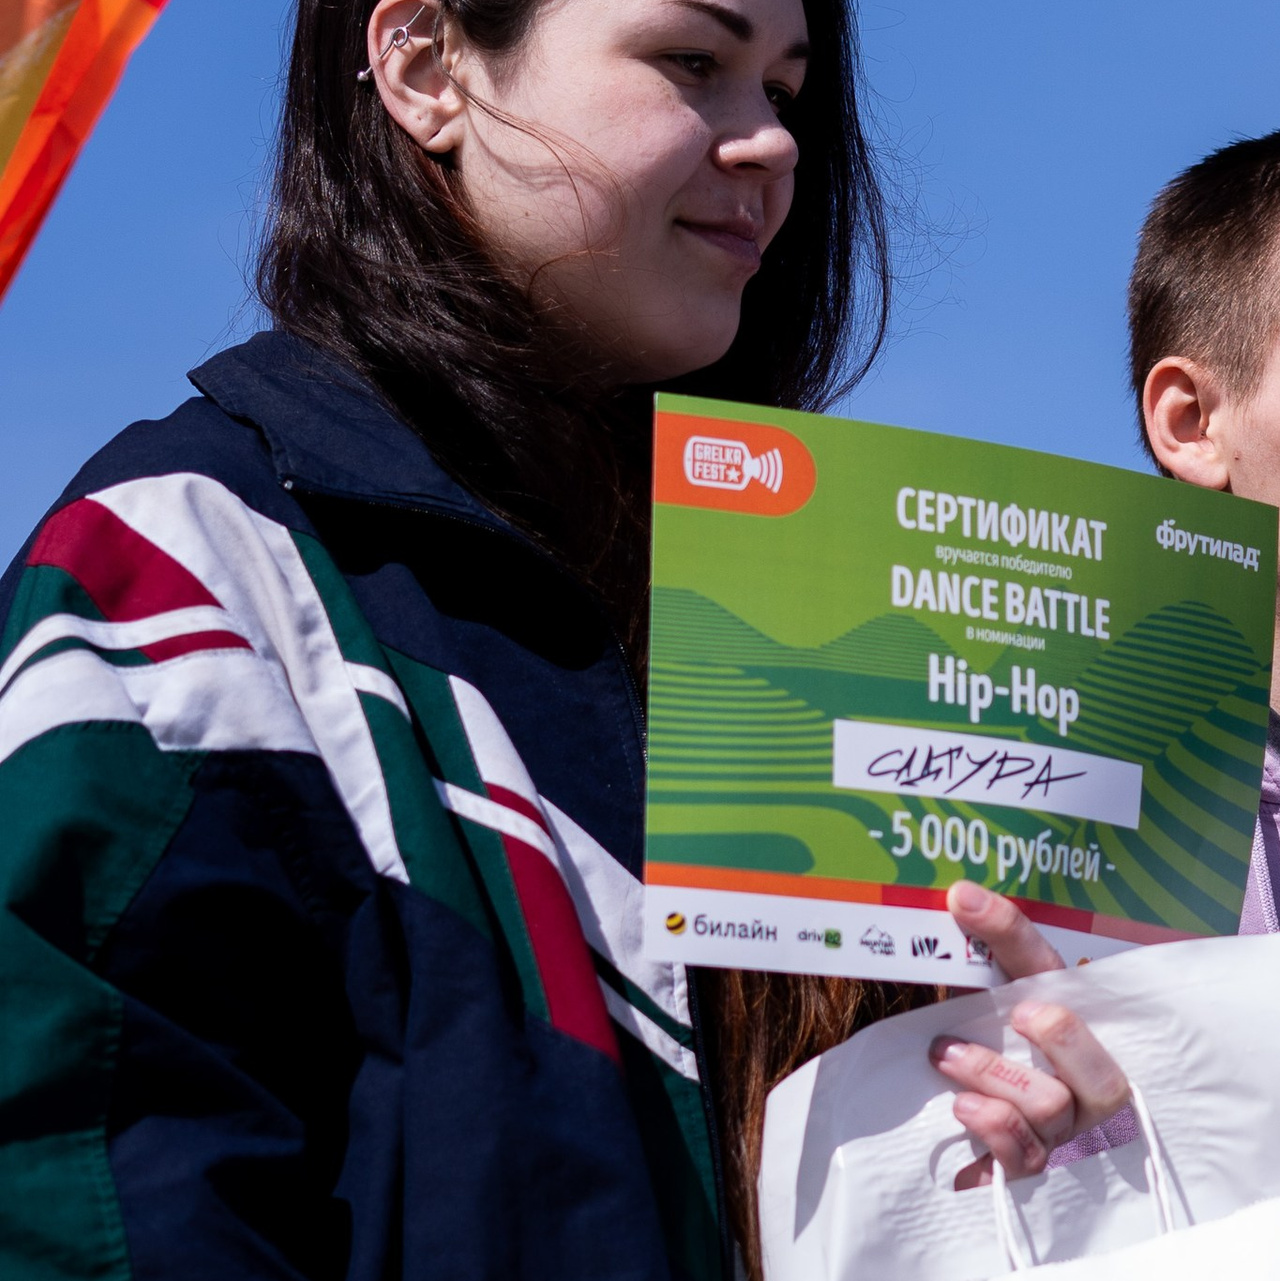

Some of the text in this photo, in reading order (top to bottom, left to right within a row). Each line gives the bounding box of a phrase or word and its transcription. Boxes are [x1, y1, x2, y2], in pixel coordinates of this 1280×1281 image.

[694, 461, 727, 481] FEST
[896, 486, 1107, 561] СЕРТИФИКАТ
[935, 544, 1073, 580] вручается победителю
[891, 564, 1110, 639] DANCE BATTLE
[975, 627, 1046, 651] номинации
[928, 653, 1080, 737] Hip-Hop
[996, 828, 1101, 883] рублей
[693, 914, 778, 942] билайн
